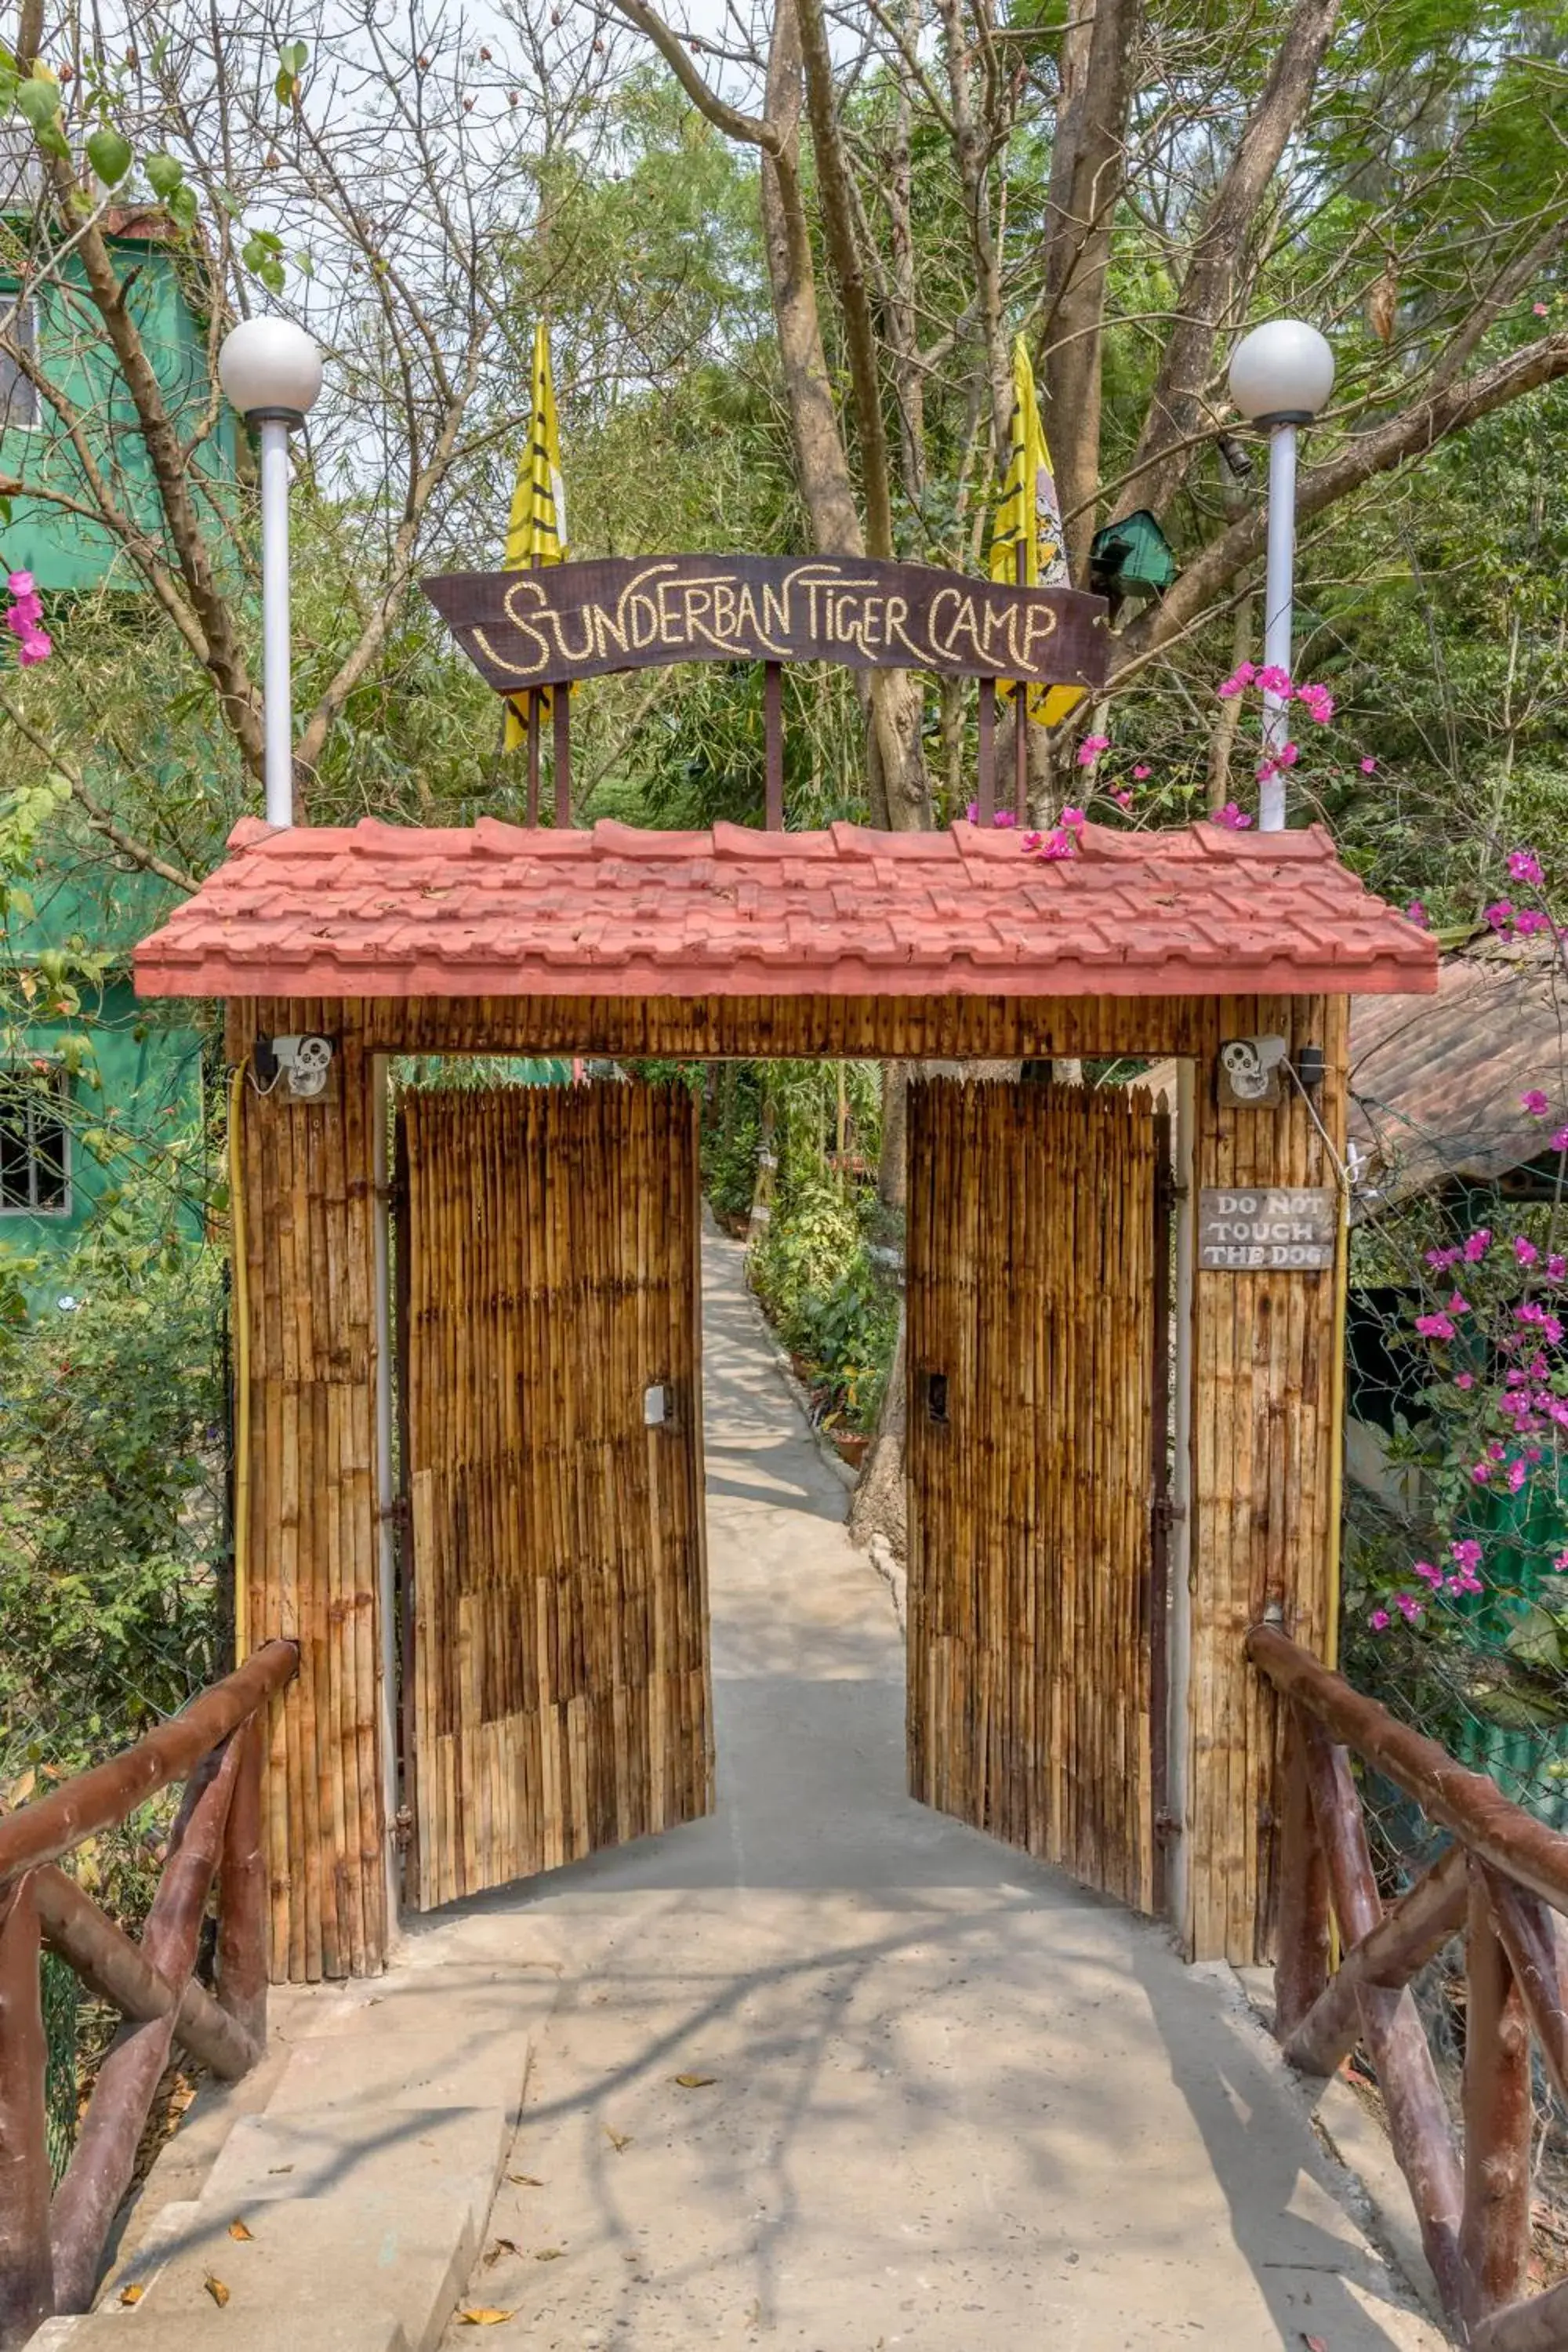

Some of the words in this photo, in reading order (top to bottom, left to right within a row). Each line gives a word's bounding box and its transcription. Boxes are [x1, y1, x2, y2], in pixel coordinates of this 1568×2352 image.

[472, 564, 841, 675] SUNDERBAN
[928, 588, 1057, 672] CAMP
[1218, 1196, 1257, 1214] DO
[1267, 1196, 1323, 1214] NOT
[1207, 1221, 1313, 1241] TOUCH
[1203, 1245, 1265, 1265] THE
[1272, 1246, 1322, 1265] DOG
